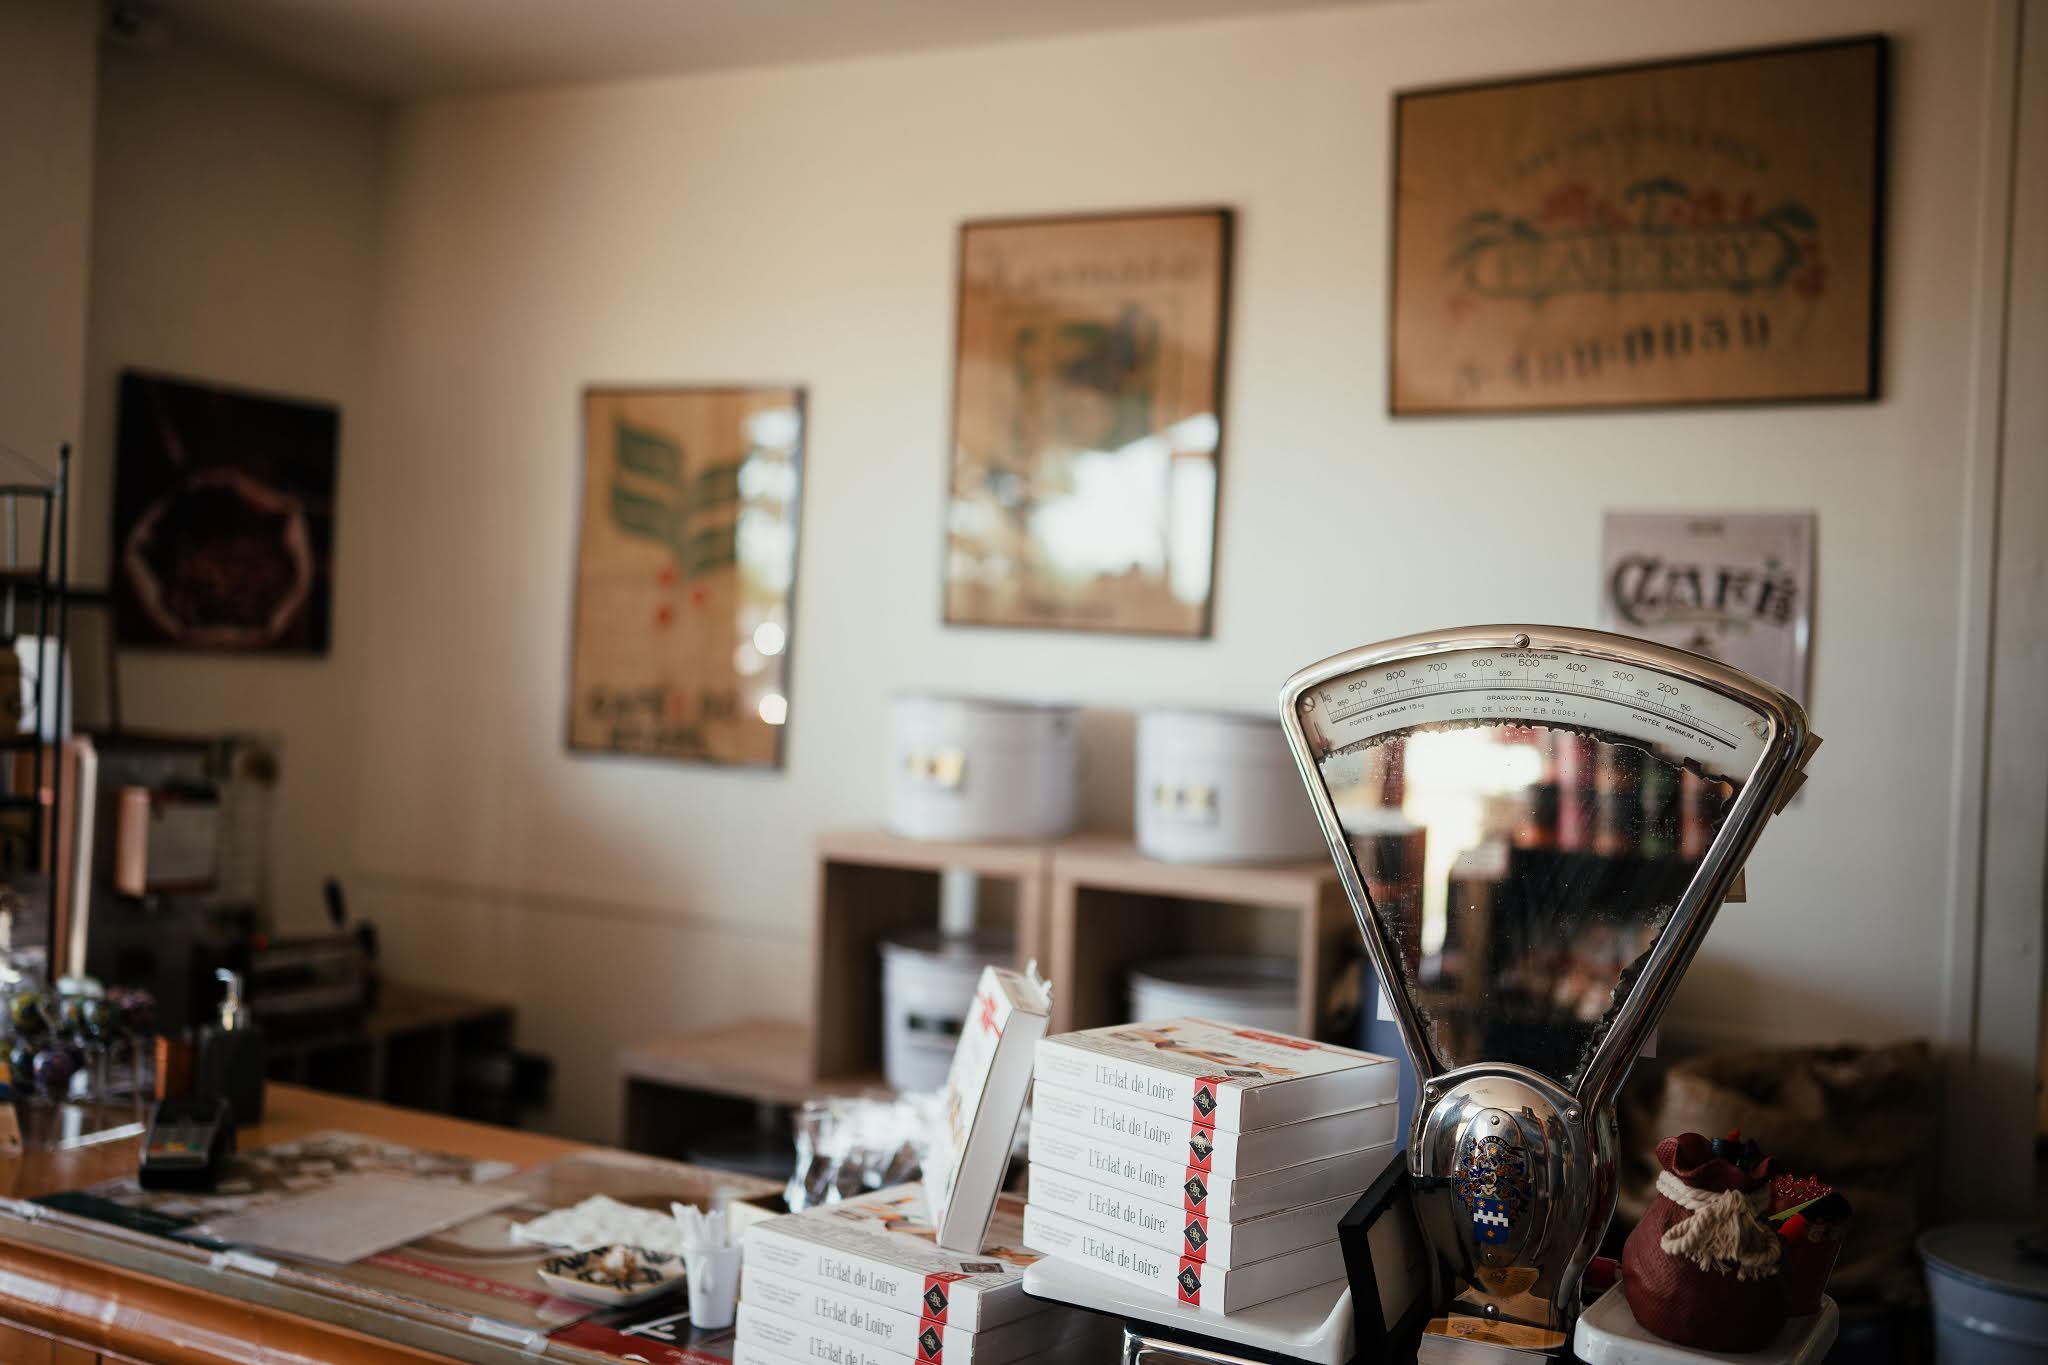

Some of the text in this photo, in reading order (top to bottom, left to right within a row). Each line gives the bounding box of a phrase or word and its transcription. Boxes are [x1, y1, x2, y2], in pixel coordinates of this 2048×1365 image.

[1348, 680, 1368, 693] 900
[1386, 670, 1406, 681] 800
[1427, 663, 1448, 672] 700
[1471, 659, 1493, 667] 600
[1518, 659, 1540, 667] 500
[1566, 662, 1587, 673] 400
[1612, 671, 1634, 682] 300
[1657, 682, 1679, 696] 200
[1411, 678, 1425, 686] 750
[1591, 678, 1604, 687] 350
[1636, 689, 1649, 698] 250
[1680, 703, 1692, 712] 150
[1377, 706, 1407, 718] MAXIMUM
[1450, 706, 1477, 715] USINE
[1665, 724, 1695, 740] MINIMUM
[1131, 1074, 1144, 1093] de
[1147, 1077, 1174, 1101] Loire
[1129, 1117, 1141, 1136] de
[1144, 1121, 1171, 1145] Loire
[1124, 1160, 1136, 1179] de
[1139, 1163, 1165, 1188] Loire
[1124, 1204, 1136, 1224] de
[1139, 1208, 1165, 1233] Loire
[1118, 1249, 1130, 1269] de
[1133, 1253, 1159, 1279] Loire
